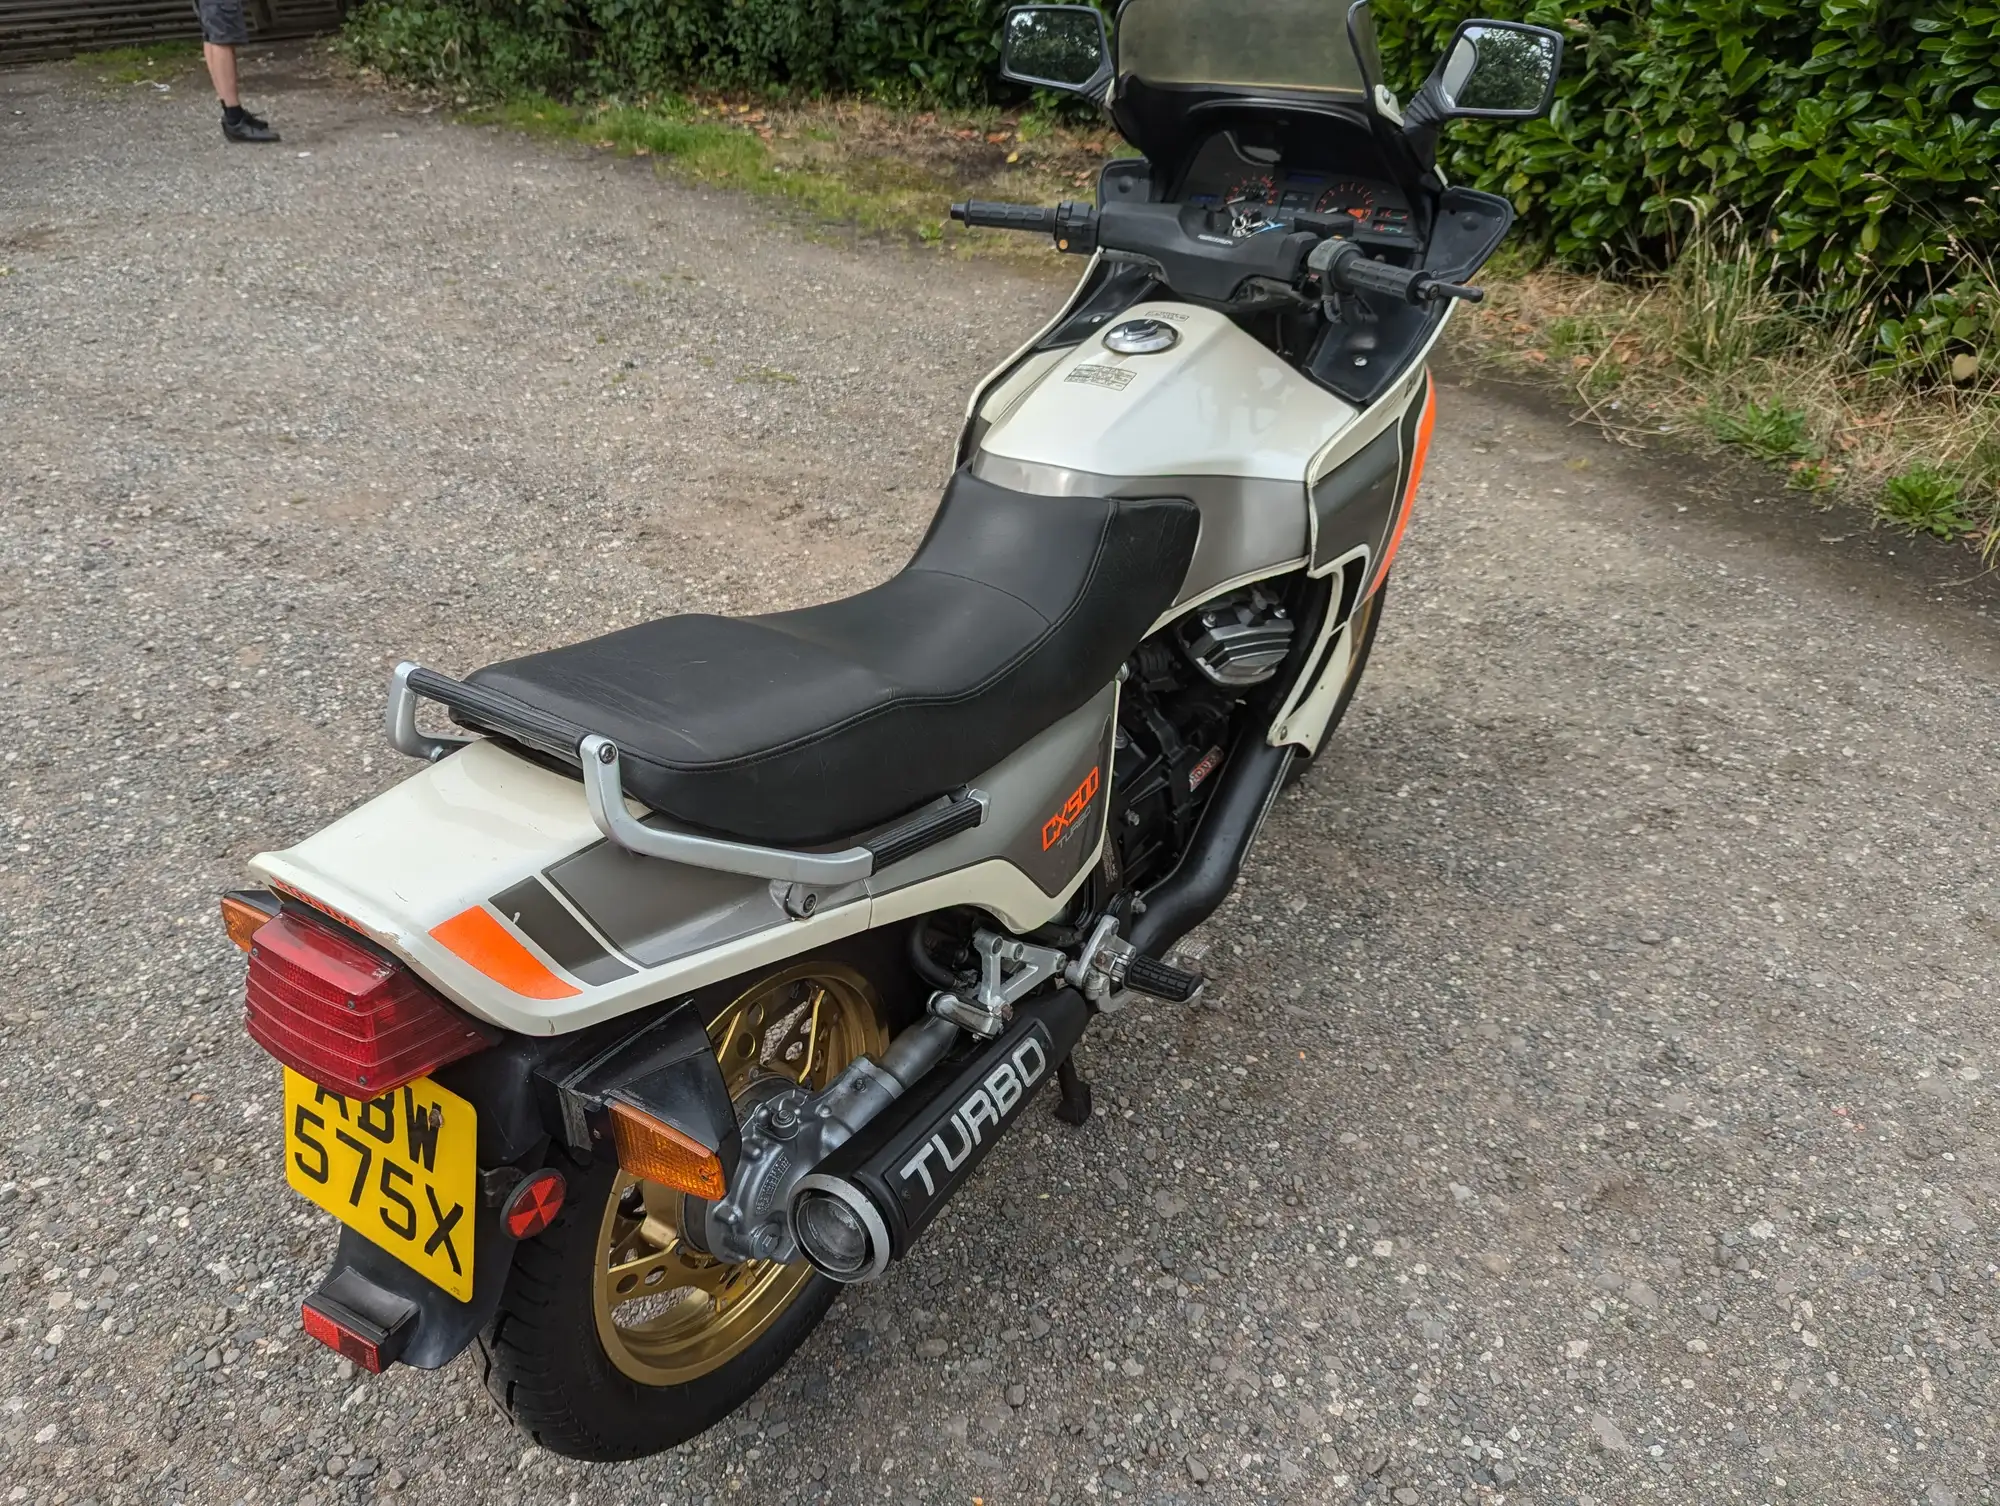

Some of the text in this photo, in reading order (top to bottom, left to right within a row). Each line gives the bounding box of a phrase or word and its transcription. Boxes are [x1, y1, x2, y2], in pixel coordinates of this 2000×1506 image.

[1042, 766, 1099, 852] CX500
[295, 1104, 464, 1277] 575X
[900, 1037, 1046, 1196] TURBO
